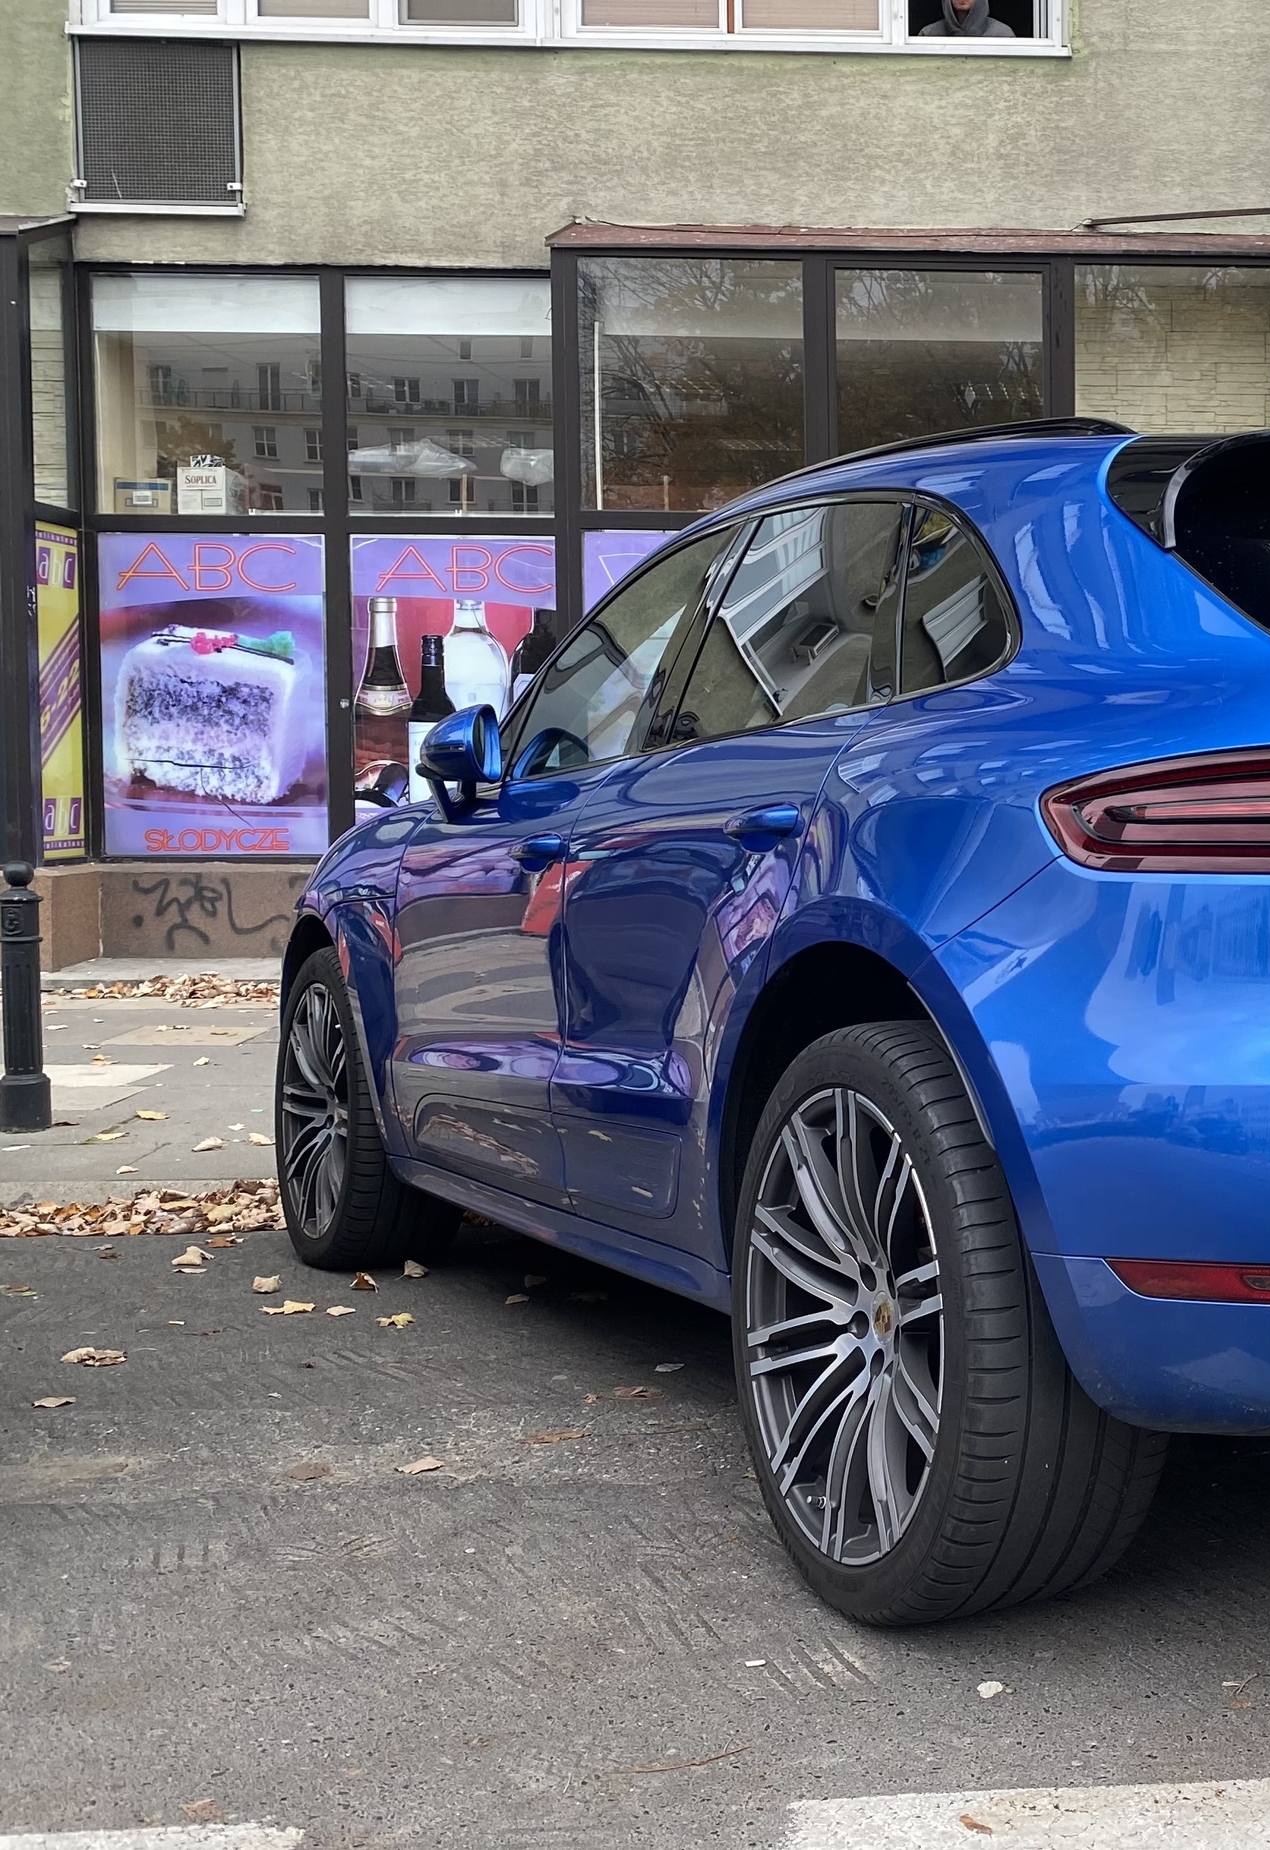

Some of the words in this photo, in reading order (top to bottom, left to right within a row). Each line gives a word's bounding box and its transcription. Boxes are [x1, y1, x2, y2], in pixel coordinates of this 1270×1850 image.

[184, 474, 217, 485] SOPLICA
[116, 542, 297, 592] ABC
[376, 545, 554, 593] ABC
[144, 828, 290, 851] SŁODYCZE
